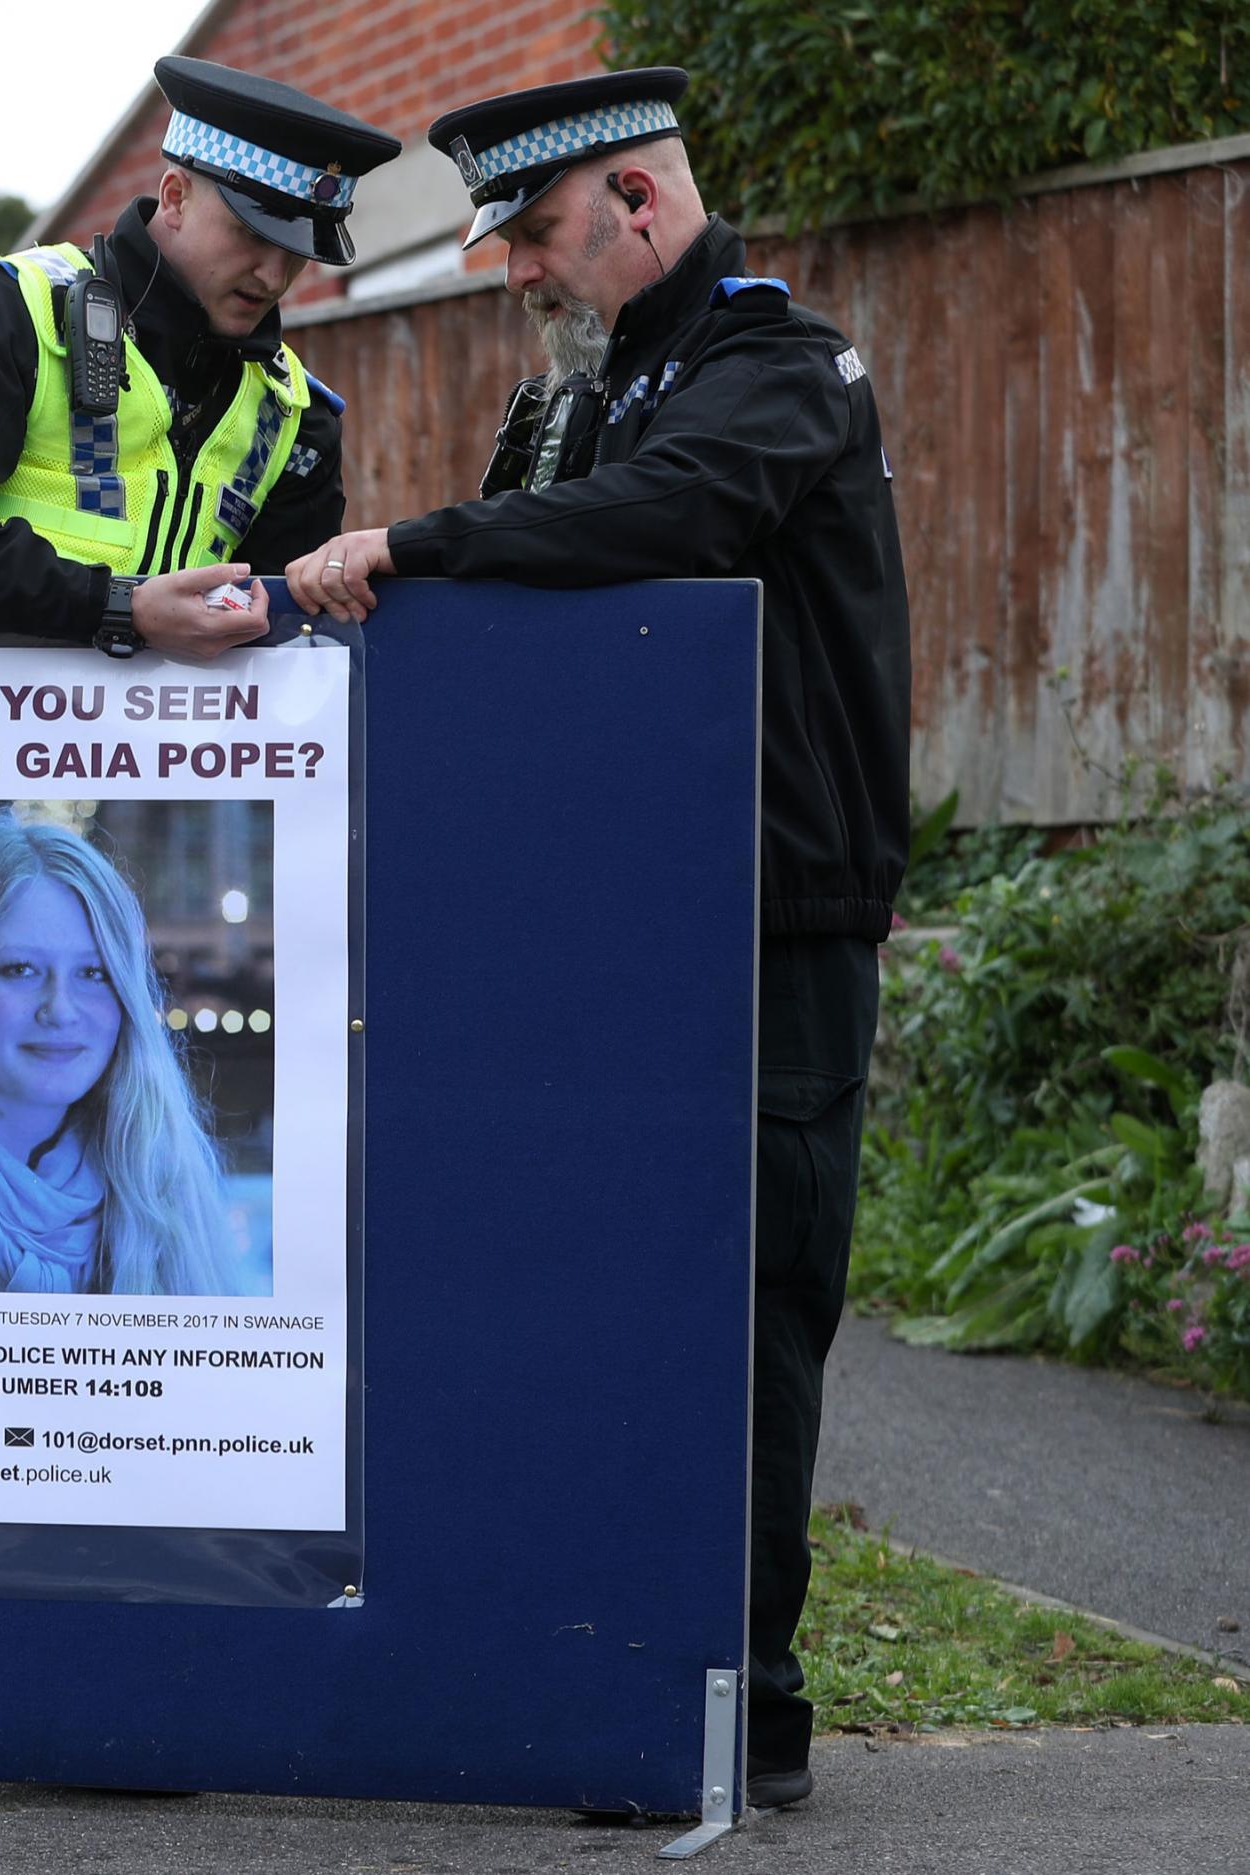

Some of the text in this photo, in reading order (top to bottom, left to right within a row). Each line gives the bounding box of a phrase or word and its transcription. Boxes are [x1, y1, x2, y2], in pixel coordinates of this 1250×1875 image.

[123, 684, 259, 721] SEEN
[15, 742, 142, 779] GAIA
[158, 741, 325, 779] POPE?
[75, 1312, 84, 1326] 7
[88, 1312, 179, 1328] NOVEMBER
[182, 1314, 219, 1329] 2017
[223, 1315, 239, 1329] IN
[243, 1315, 324, 1330] SWANAGE
[61, 1347, 116, 1366] WITH
[121, 1348, 168, 1367] ANY
[173, 1349, 324, 1370] INFORMATION
[85, 1378, 163, 1398] 14:108
[42, 1430, 314, 1457] 101@dorset.pnn.police.uk
